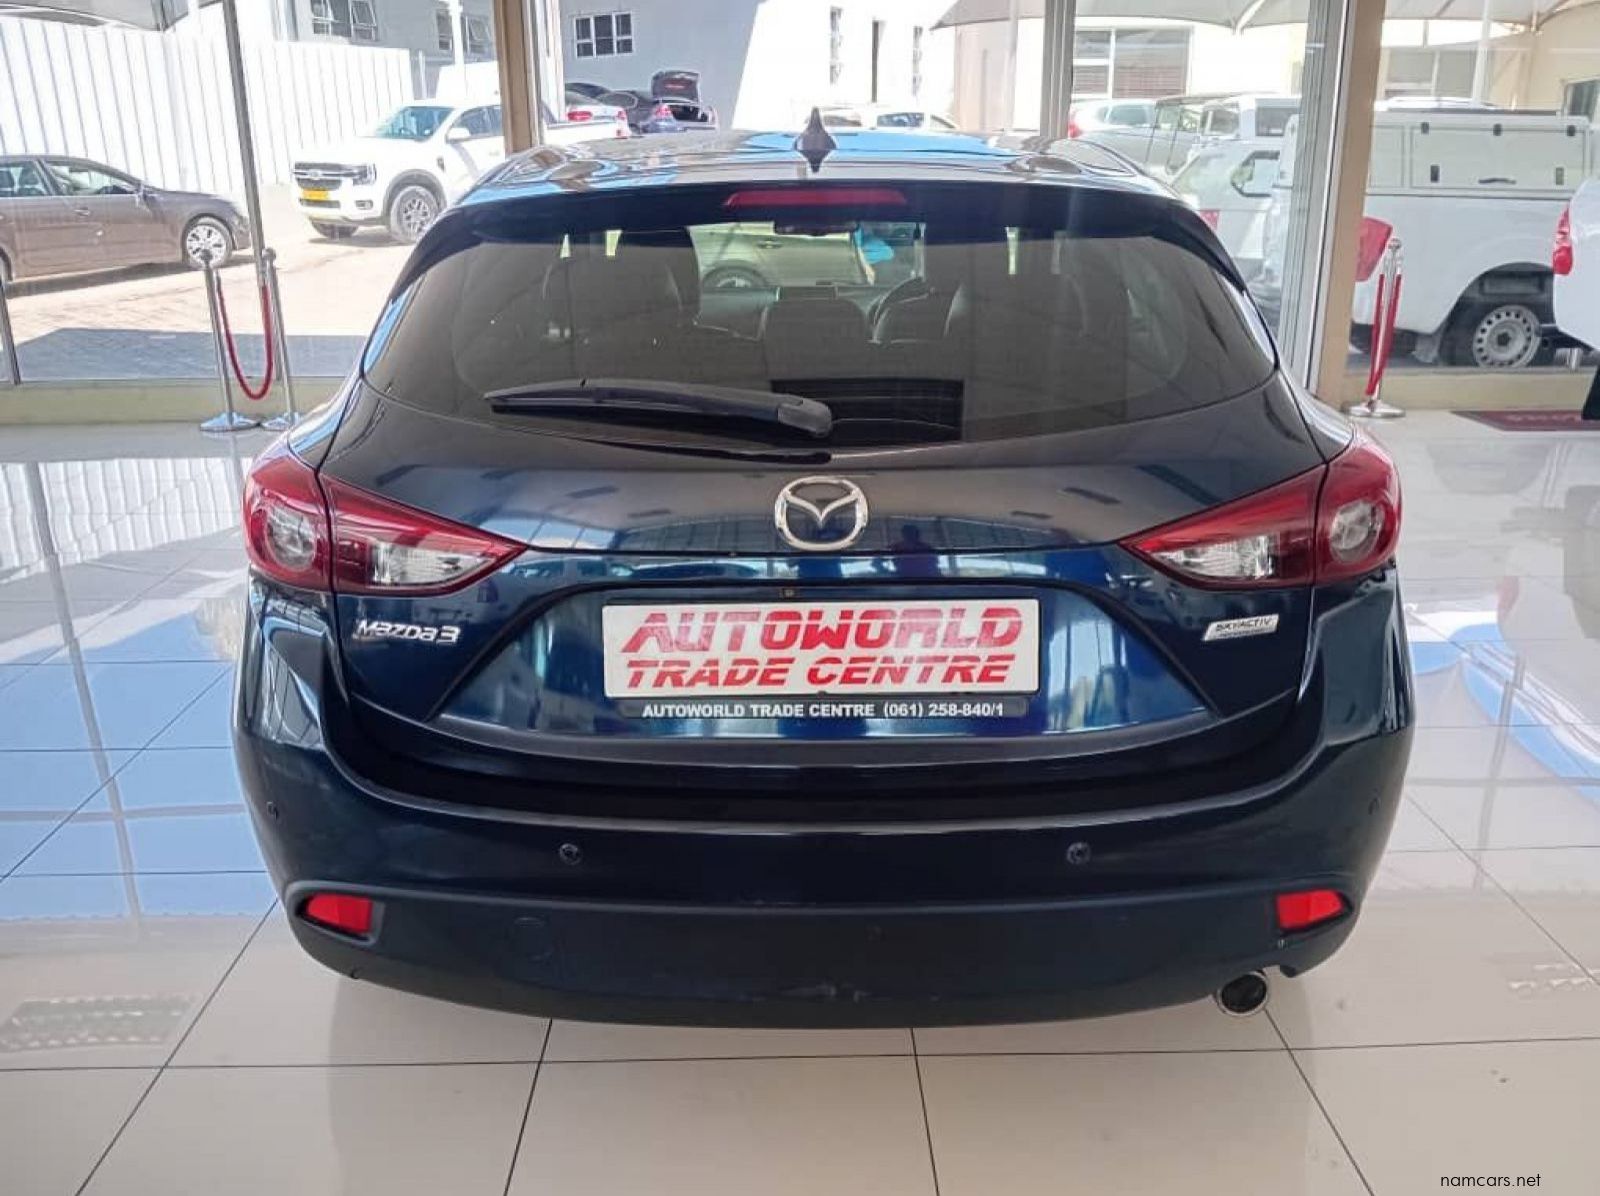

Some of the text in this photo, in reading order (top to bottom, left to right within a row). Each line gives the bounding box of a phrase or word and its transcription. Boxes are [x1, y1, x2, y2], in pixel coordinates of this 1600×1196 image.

[621, 608, 1023, 652] AUTOWORLD
[627, 655, 1015, 688] TRADE CENTRE
[642, 702, 1004, 718] AUTOWORLD TRADE CENTRE (061) 258-840/1
